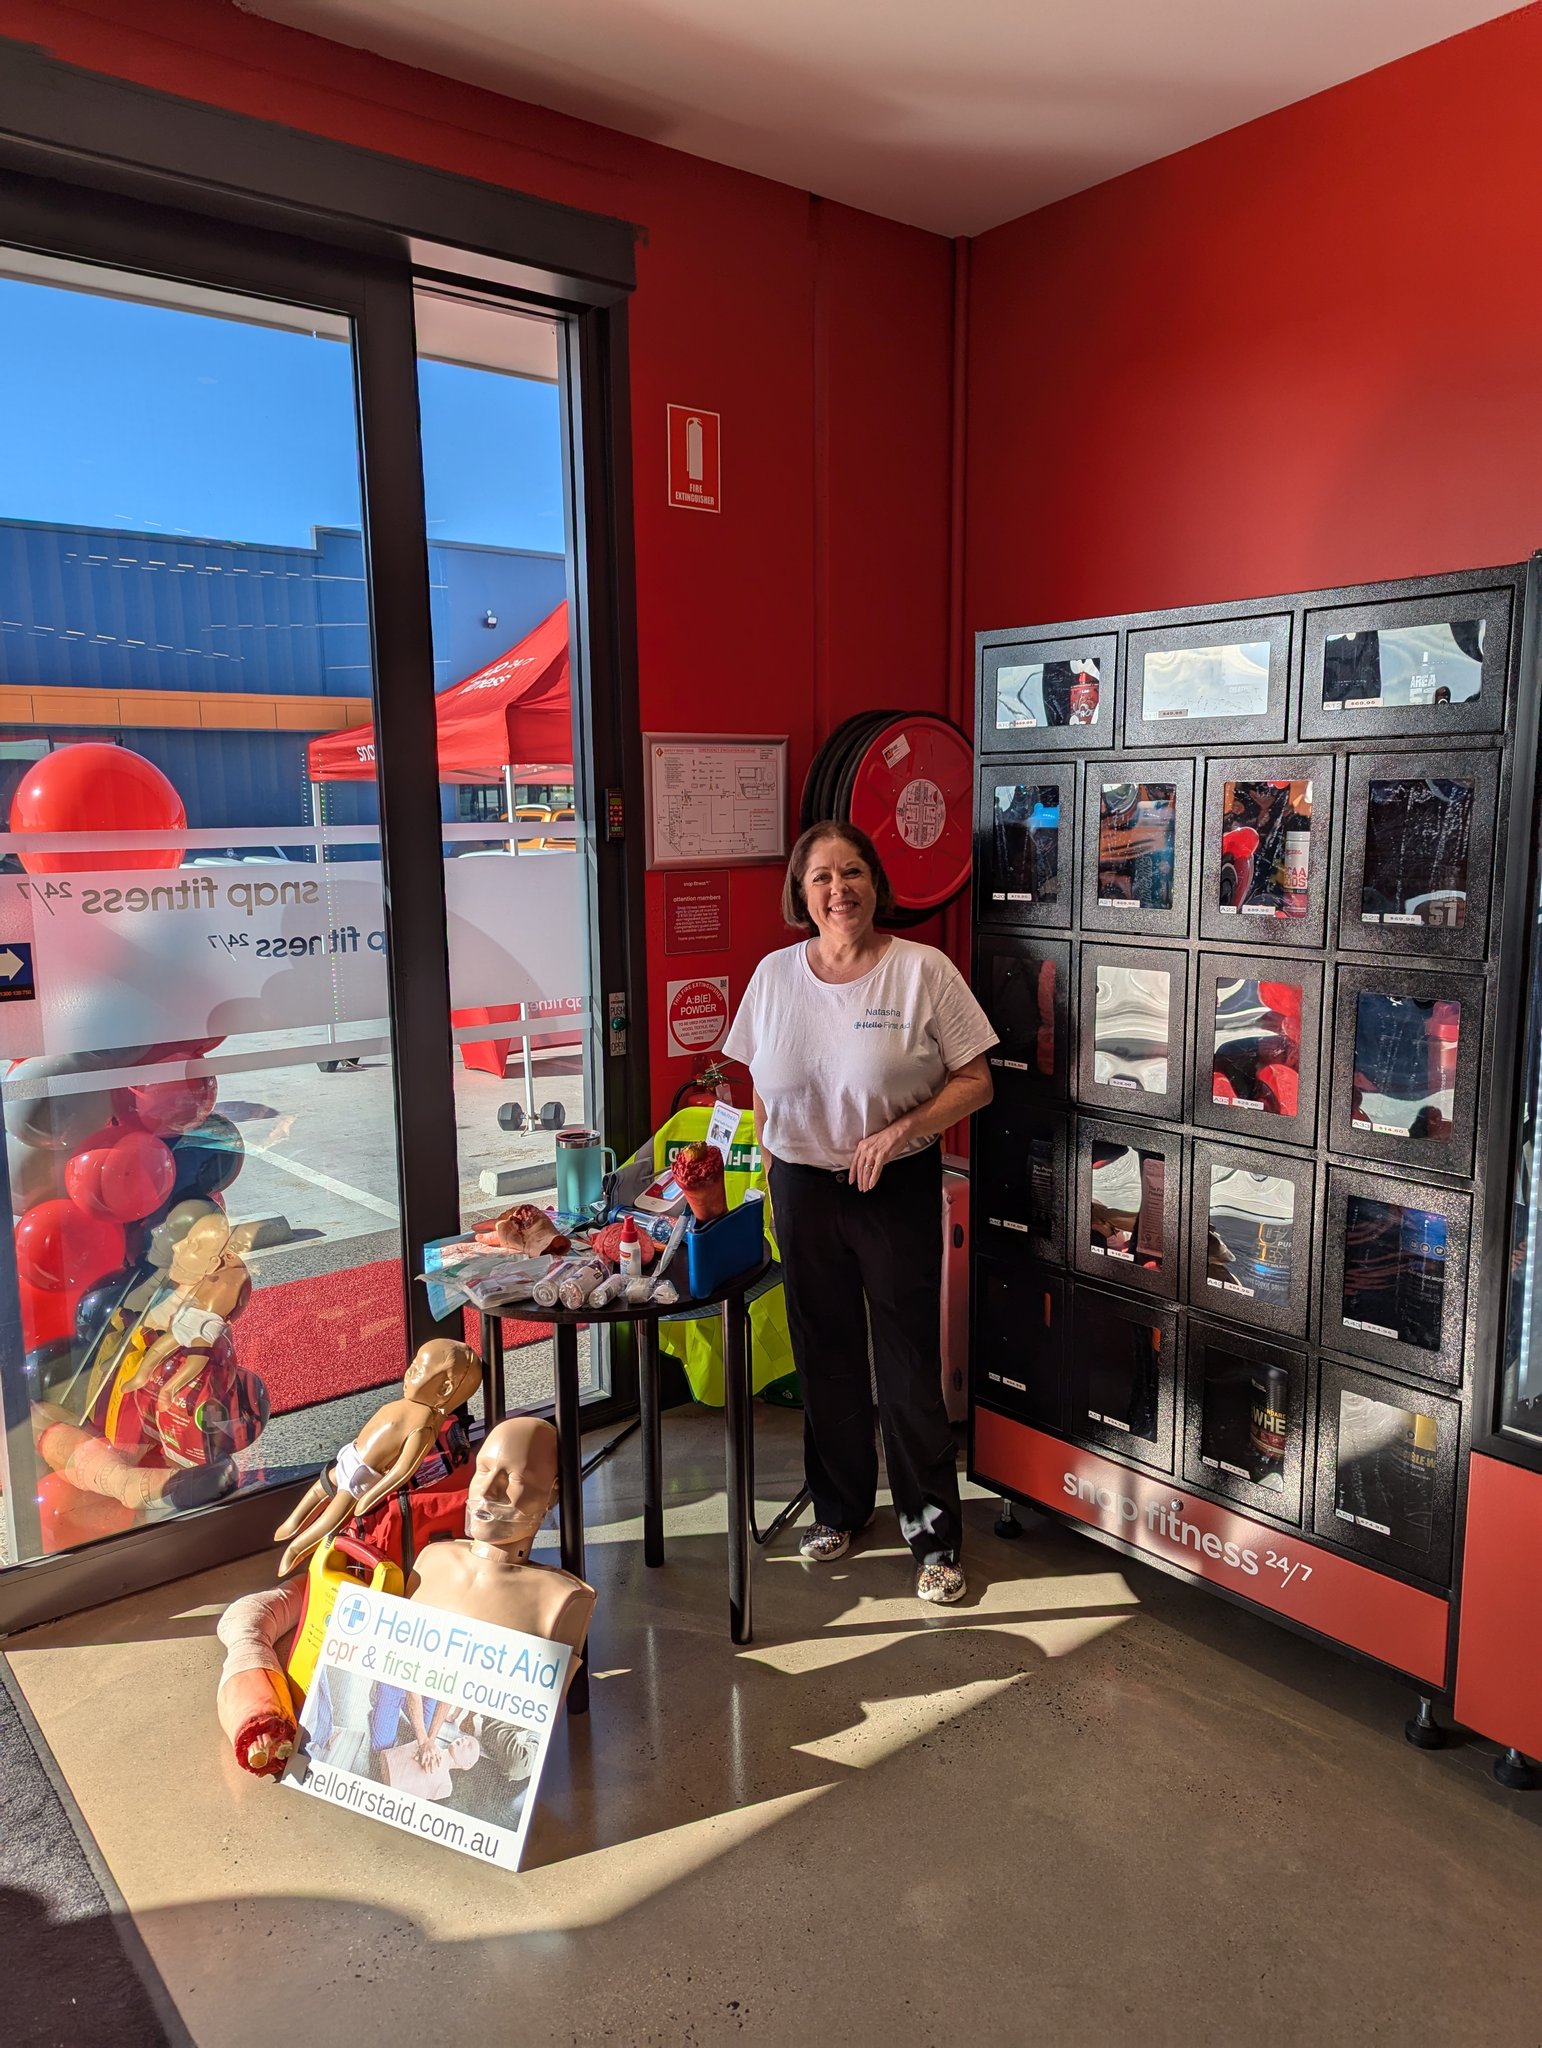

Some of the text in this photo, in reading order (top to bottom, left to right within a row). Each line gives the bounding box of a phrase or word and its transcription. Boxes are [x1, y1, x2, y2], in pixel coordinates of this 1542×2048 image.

[690, 483, 703, 494] FIRE
[675, 491, 715, 505] EXTINGUISHER
[1410, 674, 1436, 688] AREA
[672, 982, 724, 1006] THIS FIRE EXTINGUISHER
[686, 993, 711, 1005] A:B(E)
[610, 1006, 625, 1016] PUSH
[680, 1004, 717, 1016] POWDER
[866, 1008, 900, 1017] Natasha
[614, 1031, 622, 1040] TO
[611, 1041, 625, 1052] OPEN
[1092, 1246, 1104, 1254] A41
[1203, 1458, 1218, 1466] A52
[1336, 1511, 1353, 1520] A53
[1063, 1472, 1313, 1588] snap fitness 24/7
[374, 1606, 441, 1653] Hello
[444, 1627, 508, 1675] First
[509, 1648, 561, 1690] Aid
[326, 1637, 359, 1665] cpr
[361, 1645, 377, 1670] &
[382, 1650, 421, 1681] first
[424, 1667, 459, 1695] aid
[462, 1679, 549, 1724] courses
